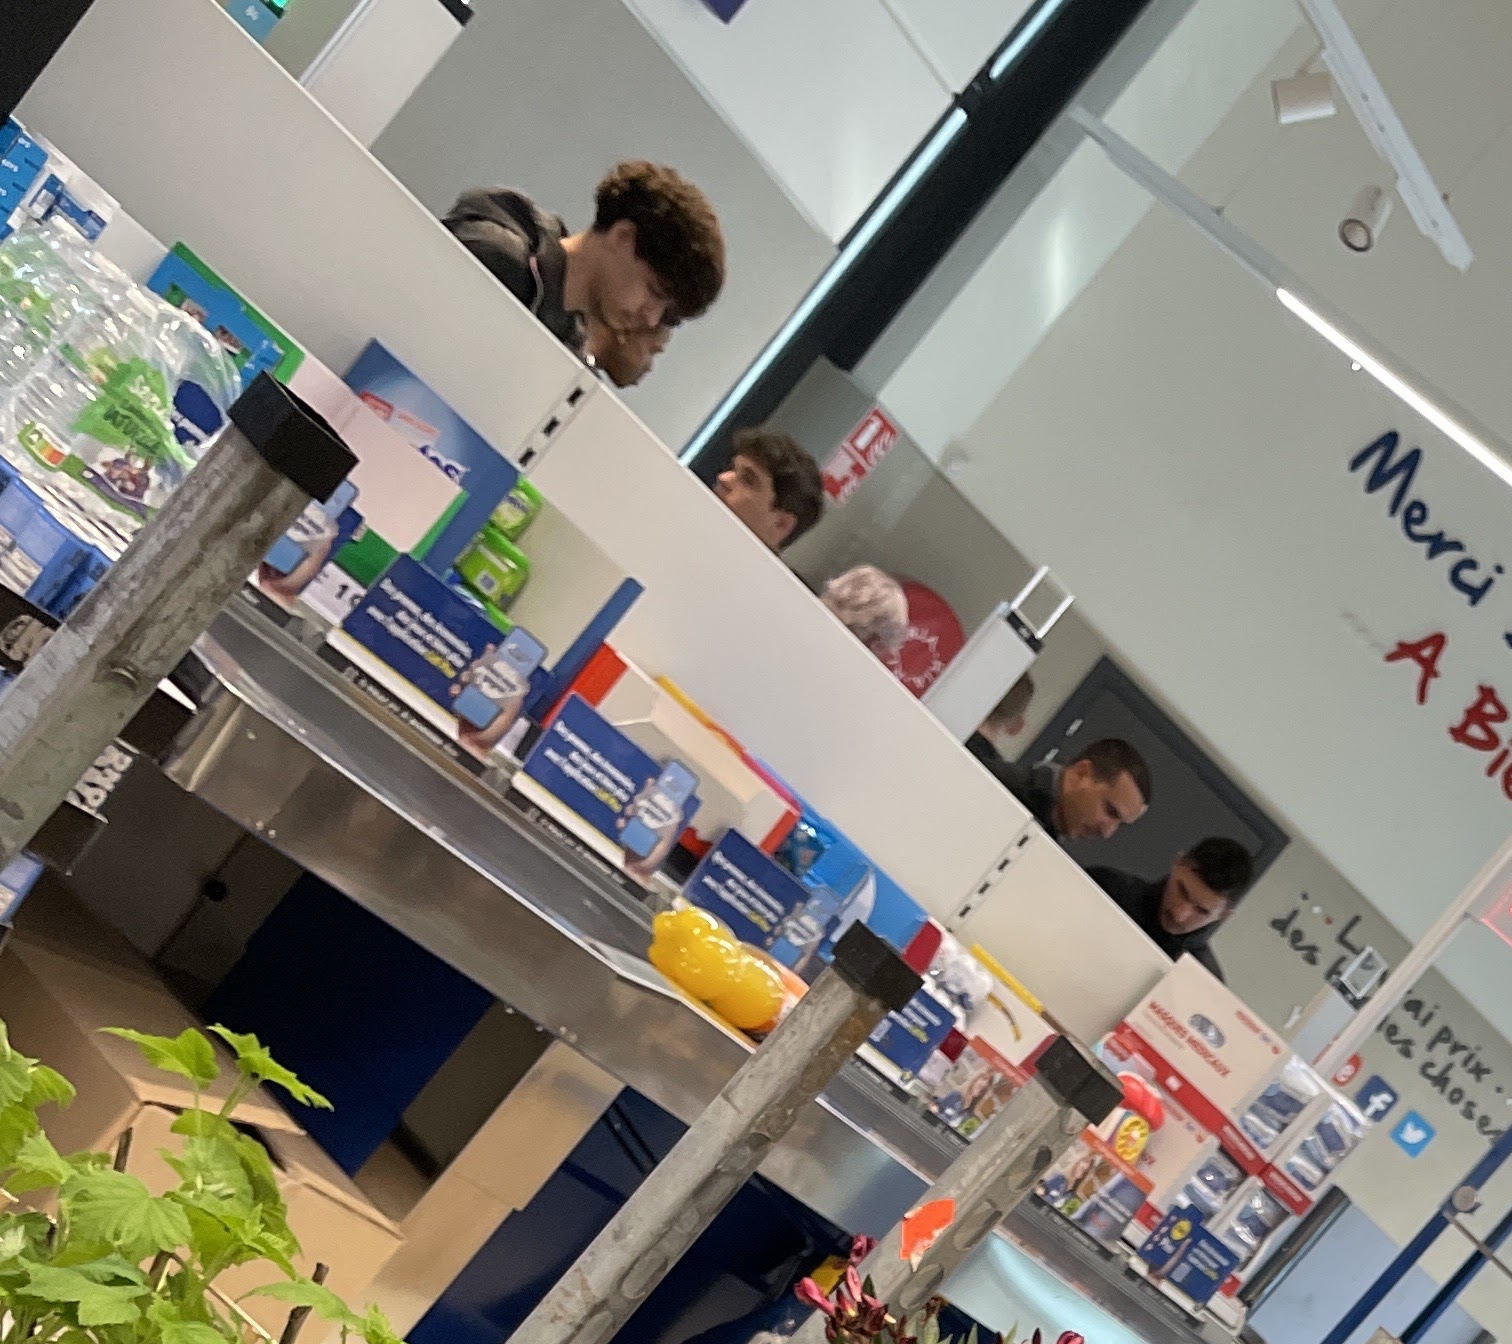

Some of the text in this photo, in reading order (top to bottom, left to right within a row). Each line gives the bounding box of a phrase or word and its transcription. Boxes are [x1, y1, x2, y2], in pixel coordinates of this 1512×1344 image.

[1349, 430, 1505, 607] Merci
[1383, 632, 1447, 705] A
[1268, 909, 1320, 966] des
[1427, 1025, 1492, 1083] prix
